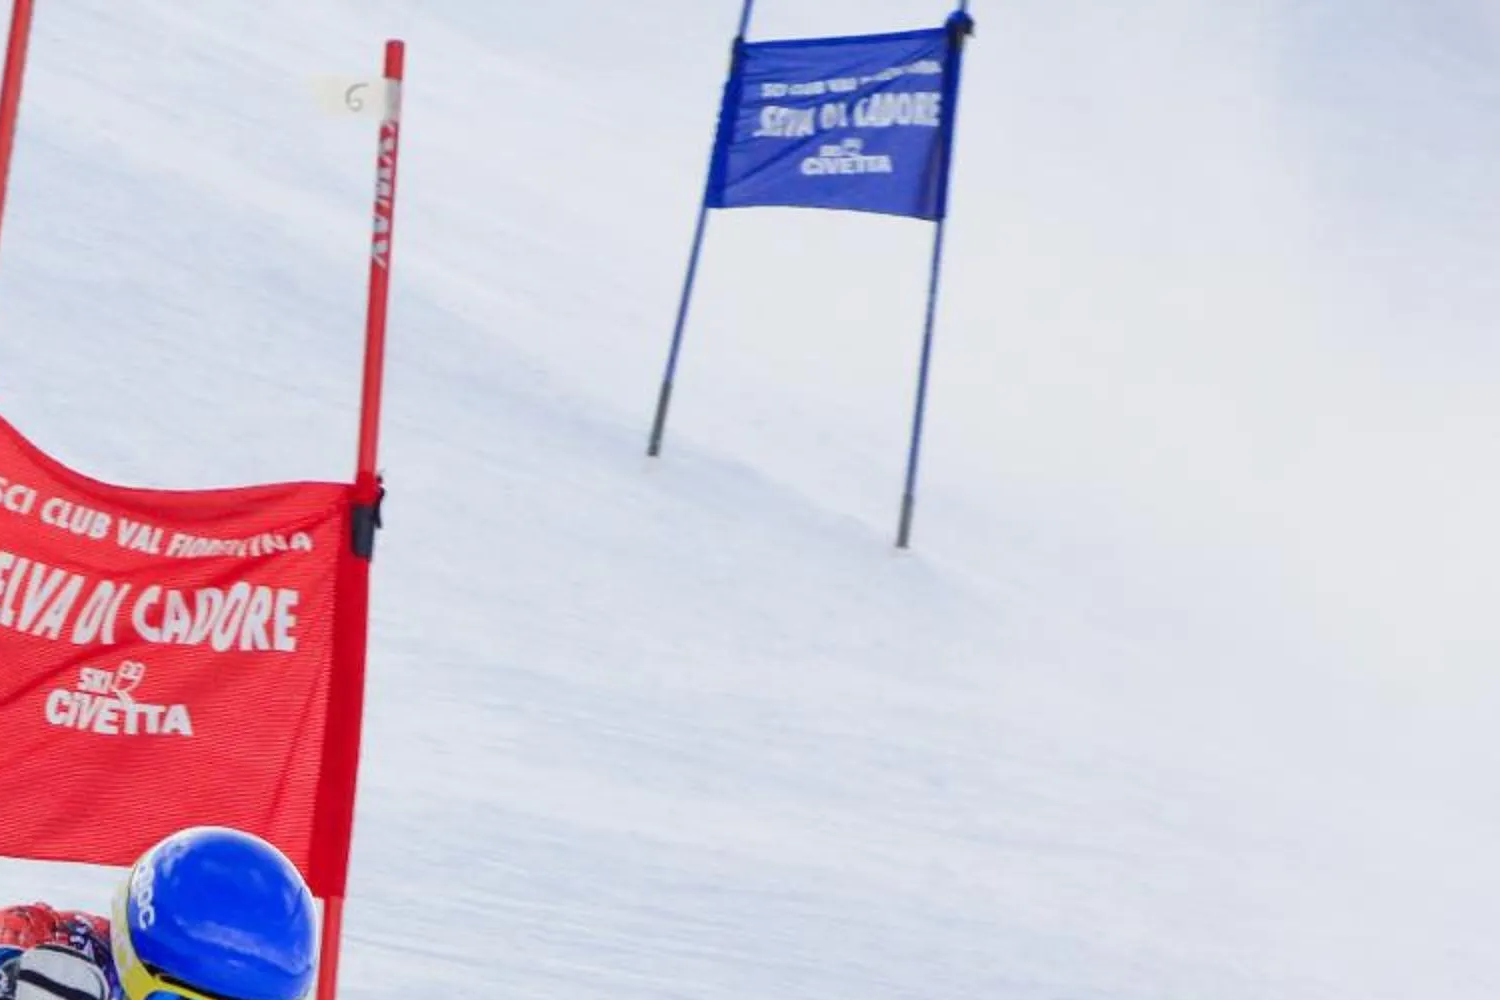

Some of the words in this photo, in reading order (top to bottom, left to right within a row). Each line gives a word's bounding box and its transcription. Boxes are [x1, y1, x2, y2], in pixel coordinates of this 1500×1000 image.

[344, 82, 369, 112] 6
[40, 497, 113, 540] CLUB
[116, 517, 165, 555] VAL
[71, 579, 132, 645] DI
[131, 580, 299, 652] CADORE
